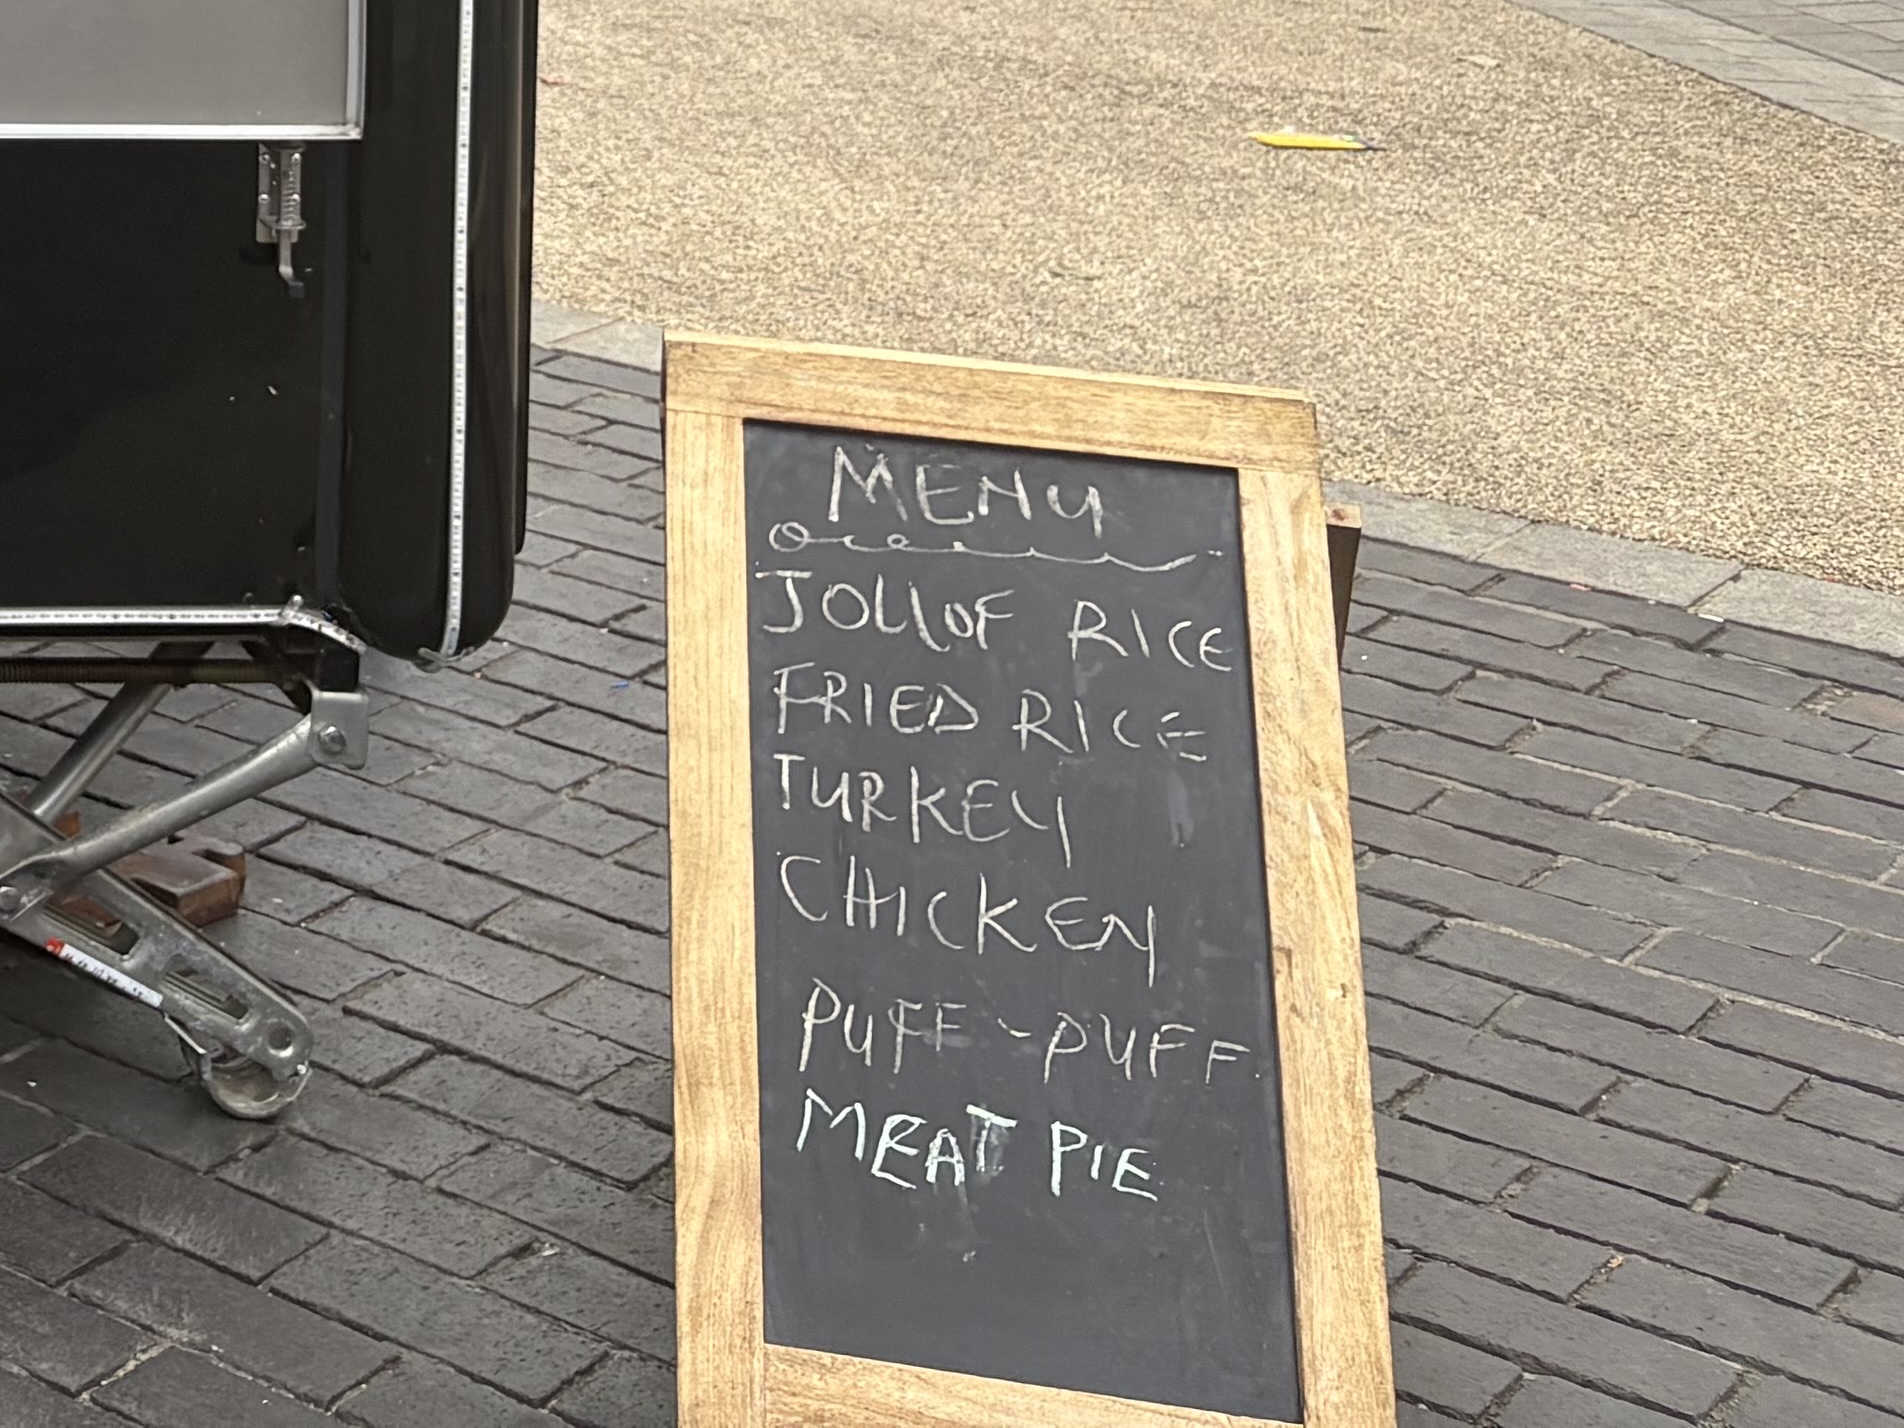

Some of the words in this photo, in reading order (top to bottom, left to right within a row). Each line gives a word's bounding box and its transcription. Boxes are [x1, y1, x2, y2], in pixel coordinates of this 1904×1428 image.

[828, 445, 1105, 538] MENU
[754, 572, 1014, 653] JOLLOF
[1068, 600, 1234, 672] RICE
[773, 661, 980, 734] FRIED
[1013, 689, 1208, 762] RICE
[773, 753, 1073, 868] TURKEY
[776, 852, 1156, 988] CHICKEN
[797, 1088, 1018, 1191] MEAT
[1050, 1120, 1159, 1202] PIE
